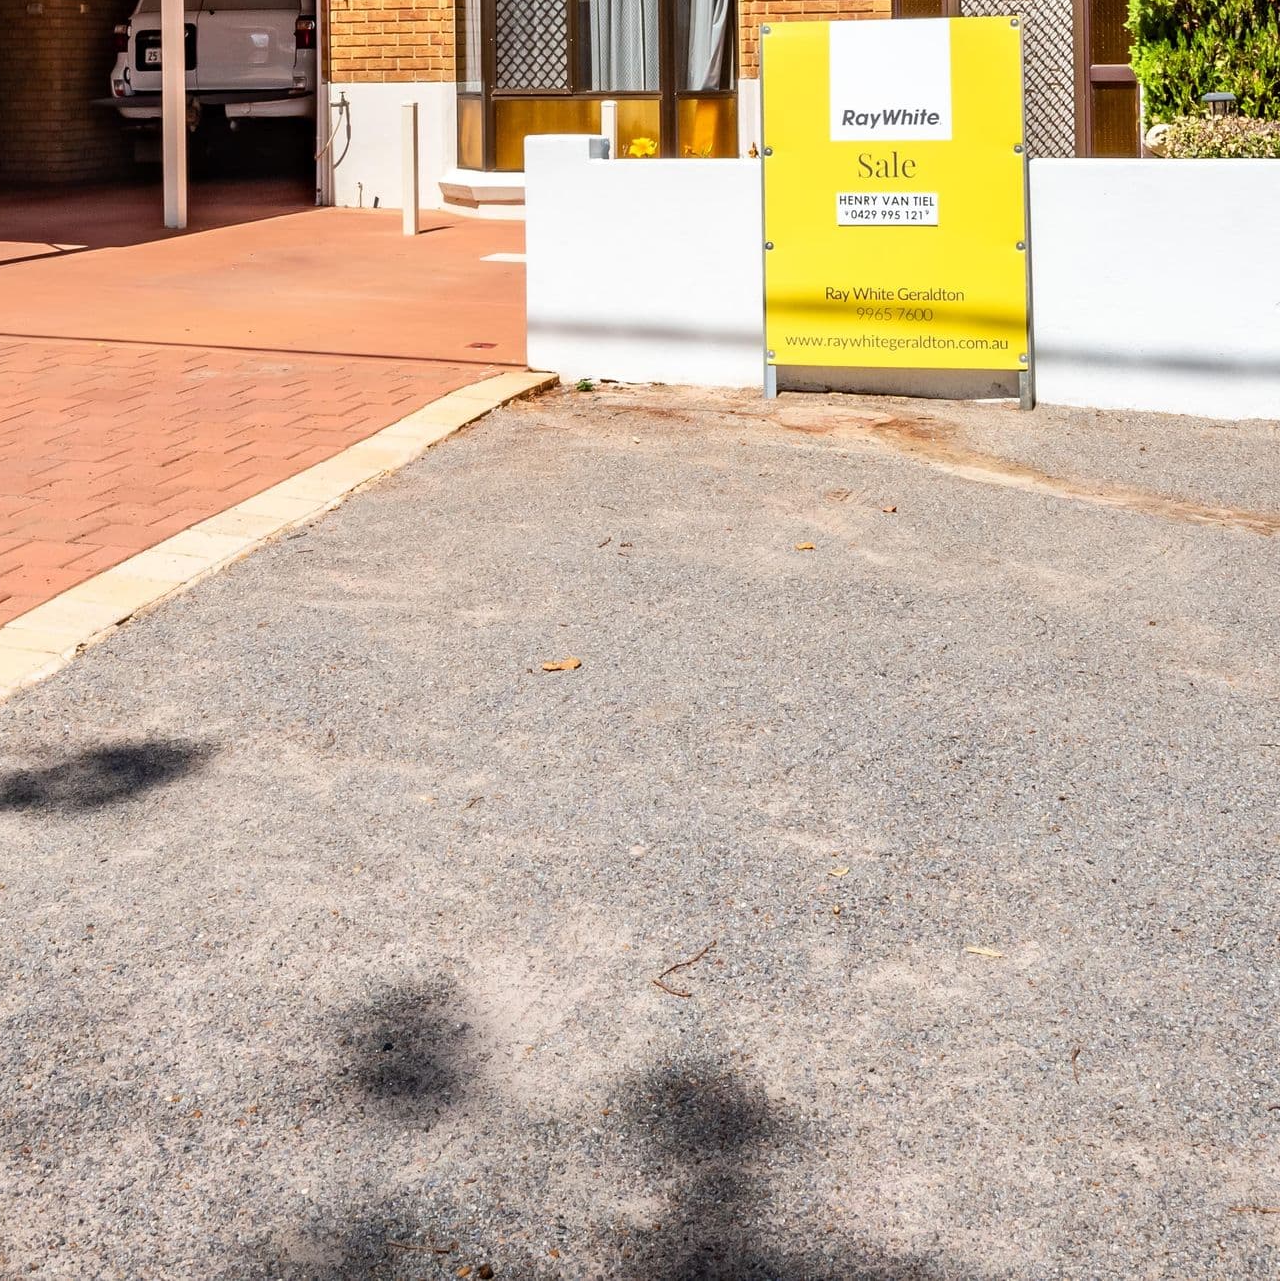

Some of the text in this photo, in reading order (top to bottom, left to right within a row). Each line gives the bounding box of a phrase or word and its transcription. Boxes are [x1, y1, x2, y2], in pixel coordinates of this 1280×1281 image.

[858, 151, 916, 178] Sale
[839, 196, 934, 206] HENRY VAN TIEL
[851, 210, 922, 220] 0429 995 121
[825, 287, 964, 302] Ray White Geraldton
[856, 307, 933, 322] 9965 7600
[785, 335, 1009, 351] www.raywhitegeraldton.com.au
